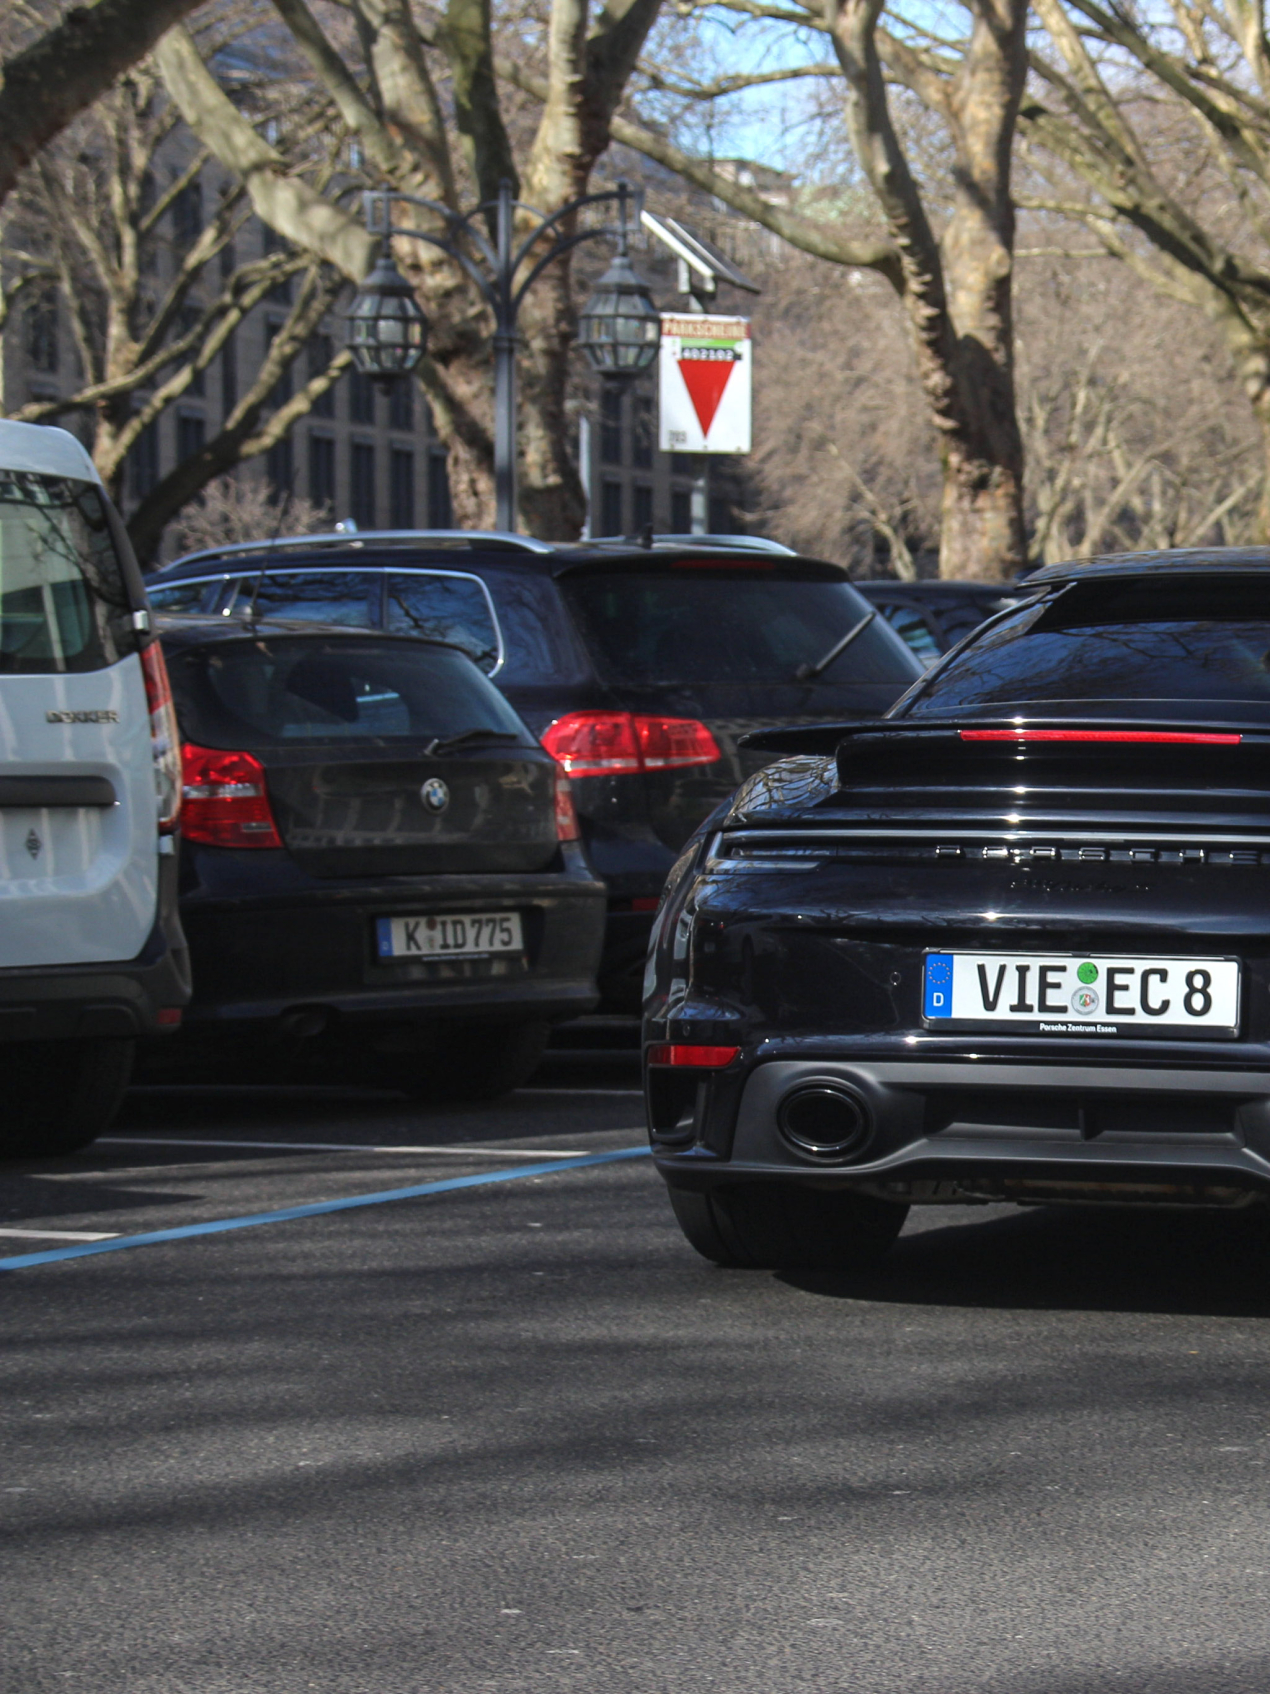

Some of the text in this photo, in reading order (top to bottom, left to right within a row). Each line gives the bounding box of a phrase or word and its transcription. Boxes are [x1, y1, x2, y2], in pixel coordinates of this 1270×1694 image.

[45, 710, 120, 724] DOKKER
[935, 845, 1261, 865] PORSCHE
[404, 919, 422, 951] K
[976, 962, 1213, 1018] VIE EC 8
[933, 992, 944, 1007] D
[1039, 1022, 1117, 1033] Porsche Zentrum Essen
